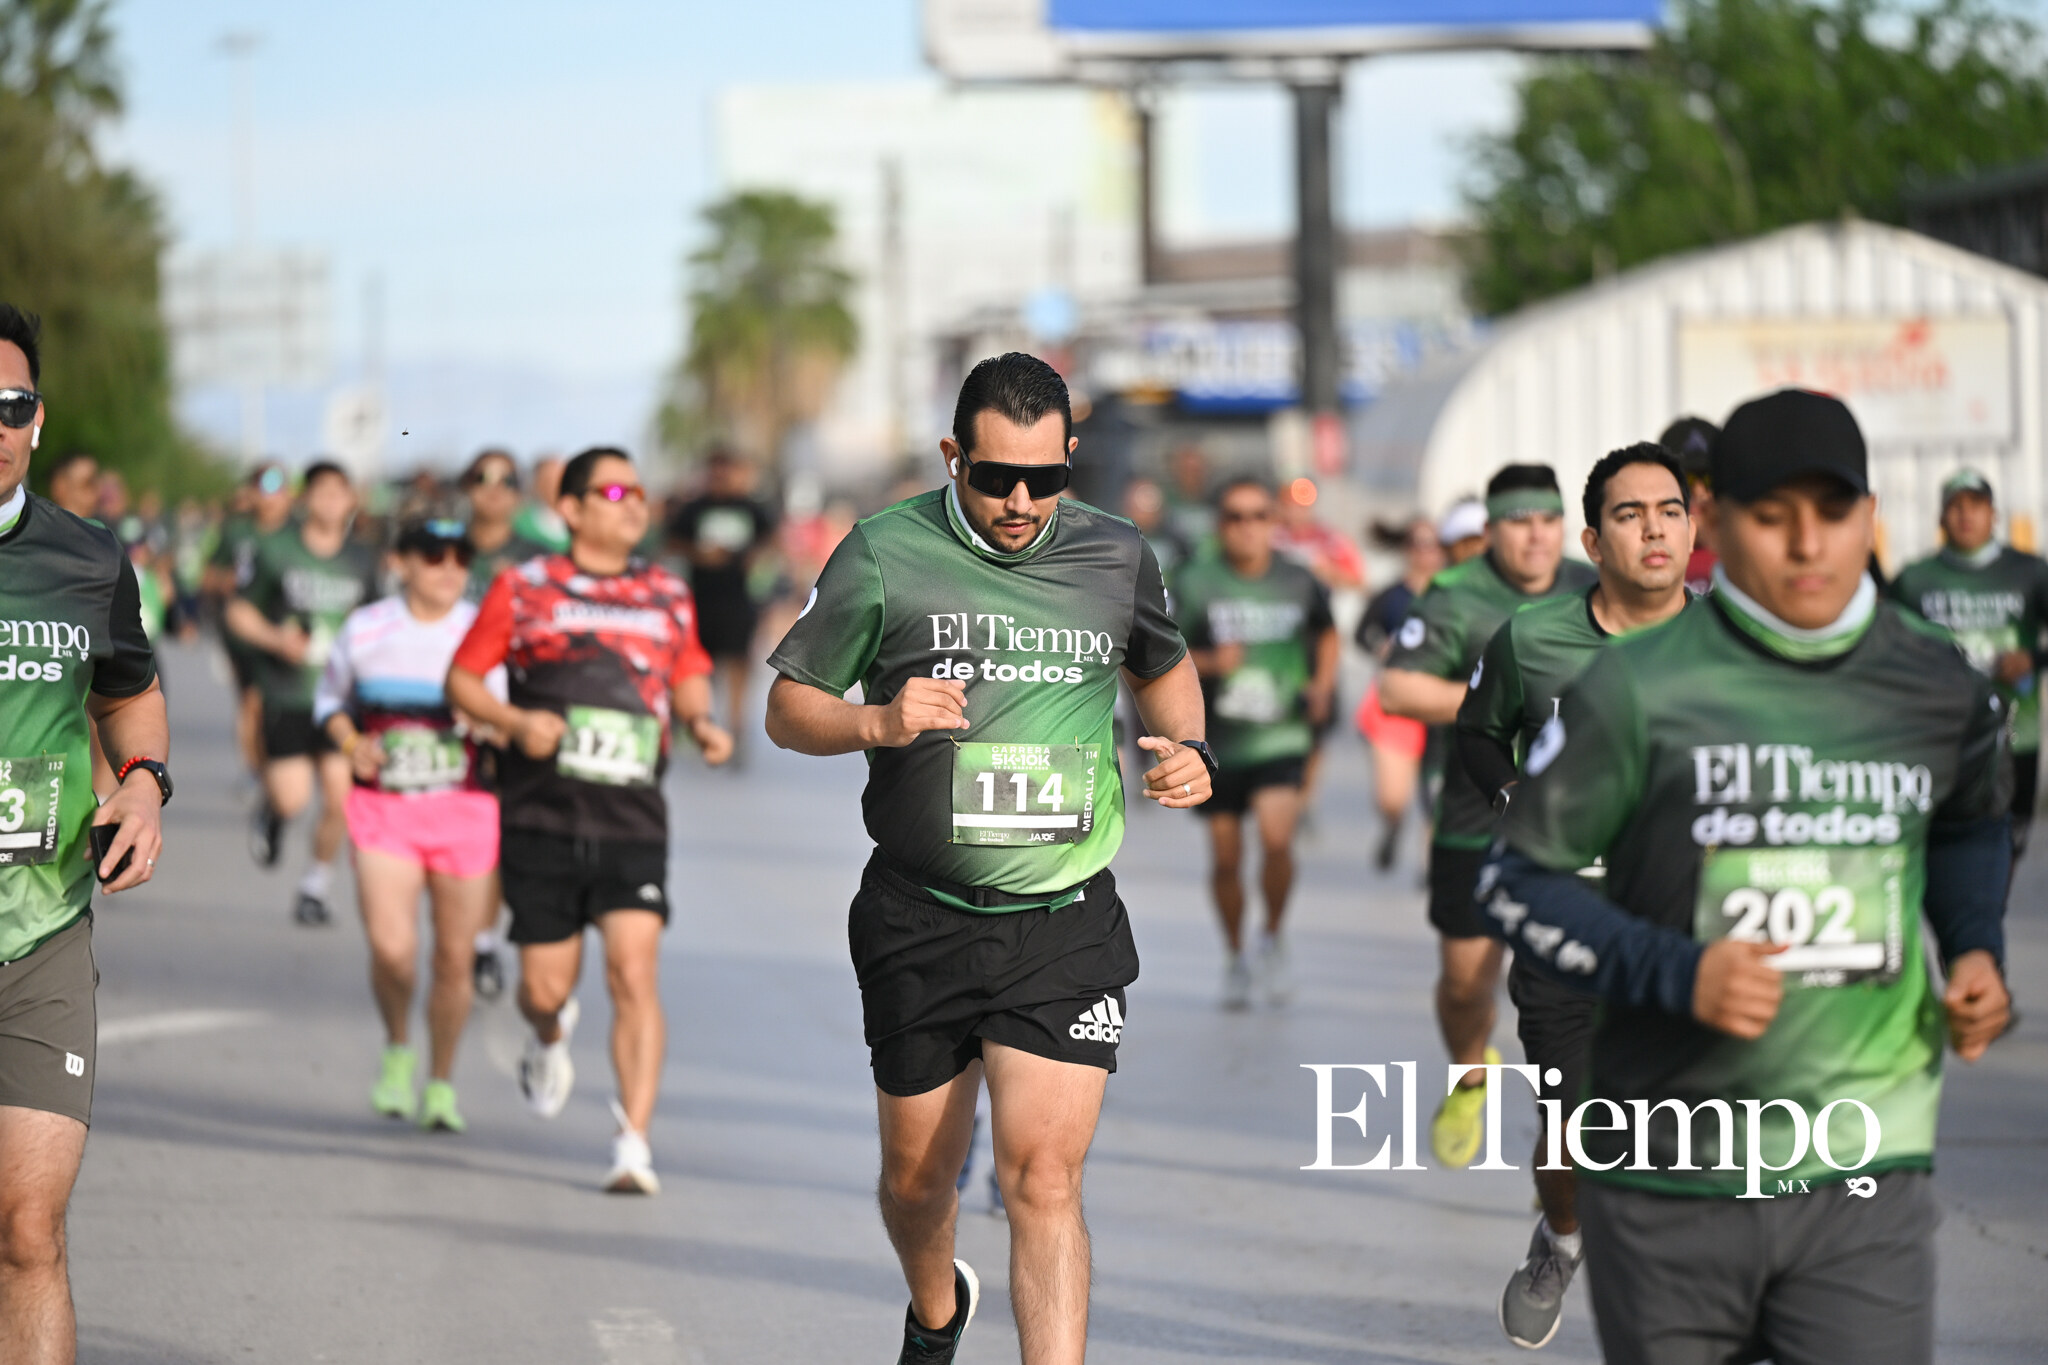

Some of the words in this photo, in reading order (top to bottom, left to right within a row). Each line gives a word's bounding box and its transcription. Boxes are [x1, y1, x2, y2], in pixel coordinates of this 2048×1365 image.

[927, 613, 971, 650] El
[977, 614, 1113, 663] Tiempo
[932, 658, 975, 680] de
[981, 659, 1083, 684] todos
[49, 761, 64, 771] 113
[992, 746, 1050, 754] CARRERA
[1086, 751, 1098, 760] 114
[976, 772, 1065, 812] 114
[1692, 743, 1751, 804] El
[1755, 744, 1932, 813] Tiempo
[45, 777, 59, 850] MEDALLA
[1082, 766, 1094, 832] MEDALLA
[1691, 806, 1759, 846] de
[1762, 805, 1901, 845] todos
[1721, 886, 1857, 947] 202
